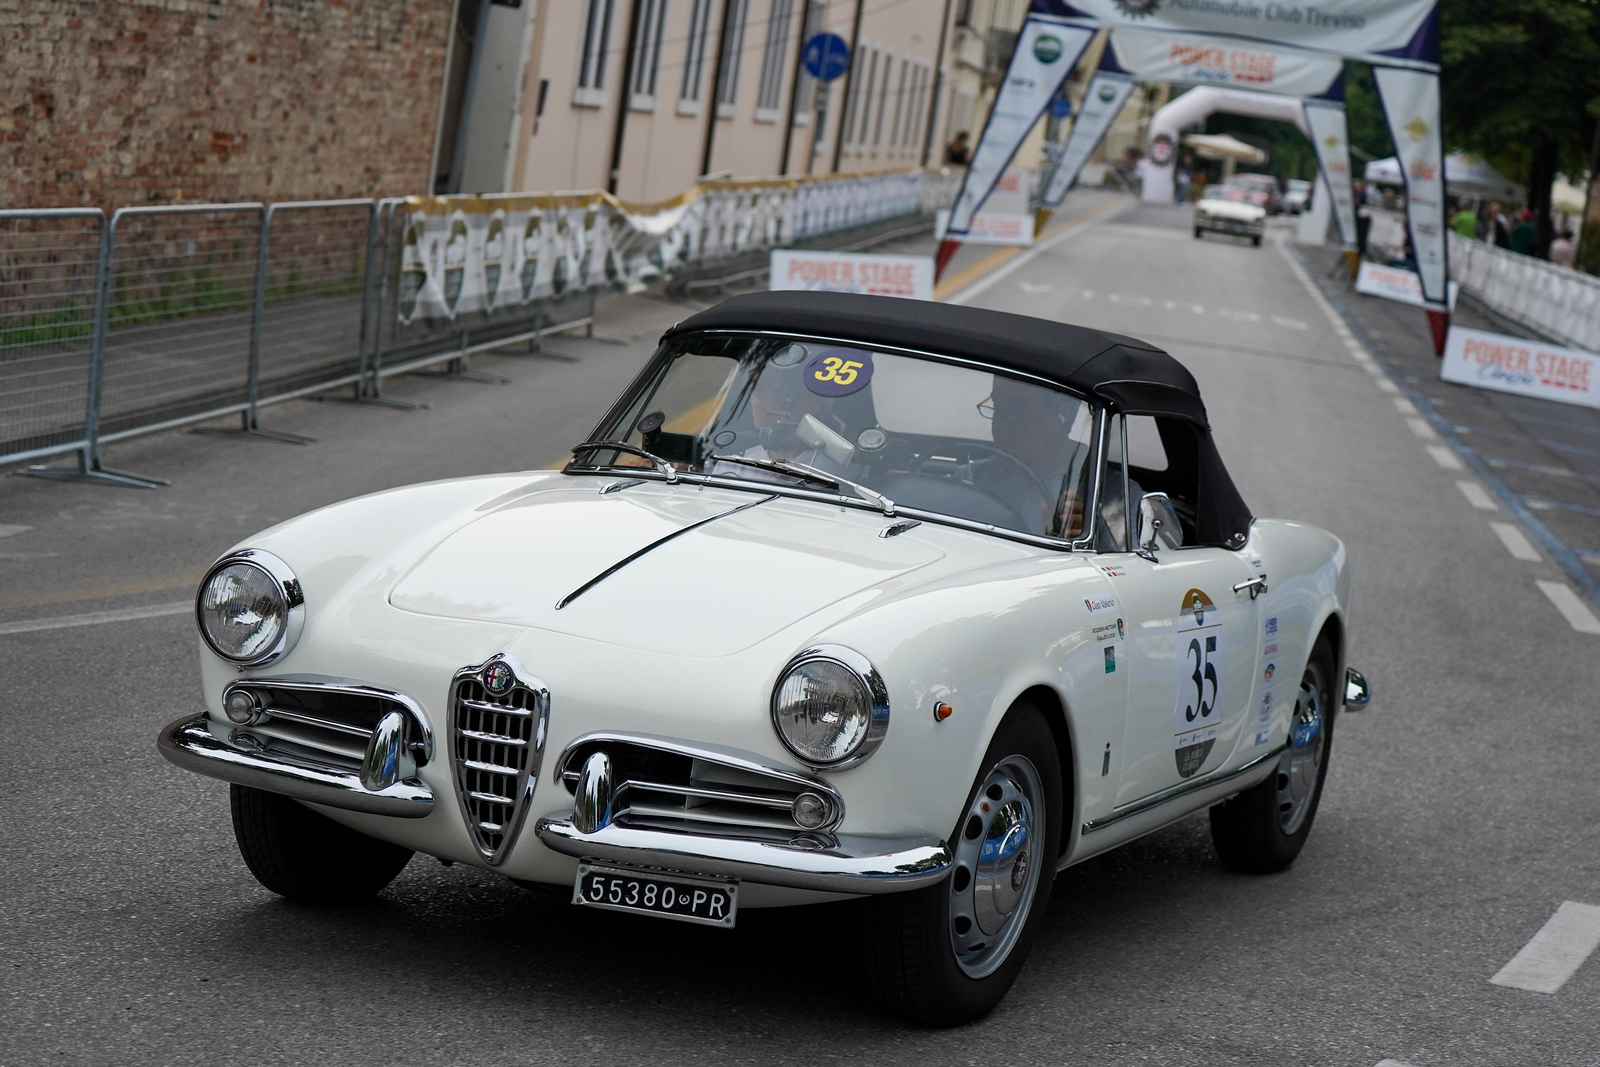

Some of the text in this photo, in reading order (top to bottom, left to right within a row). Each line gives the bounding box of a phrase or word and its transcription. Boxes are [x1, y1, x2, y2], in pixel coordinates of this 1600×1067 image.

[1265, 3, 1301, 24] Club
[1304, 7, 1367, 29] Treviso
[1170, 44, 1225, 69] POWER
[788, 258, 852, 285] POWER
[858, 262, 916, 289] STAGE
[814, 357, 864, 385] 35
[1463, 337, 1594, 387] POWER STAGE
[1185, 635, 1218, 723] 35
[590, 876, 725, 918] 55380 PR
